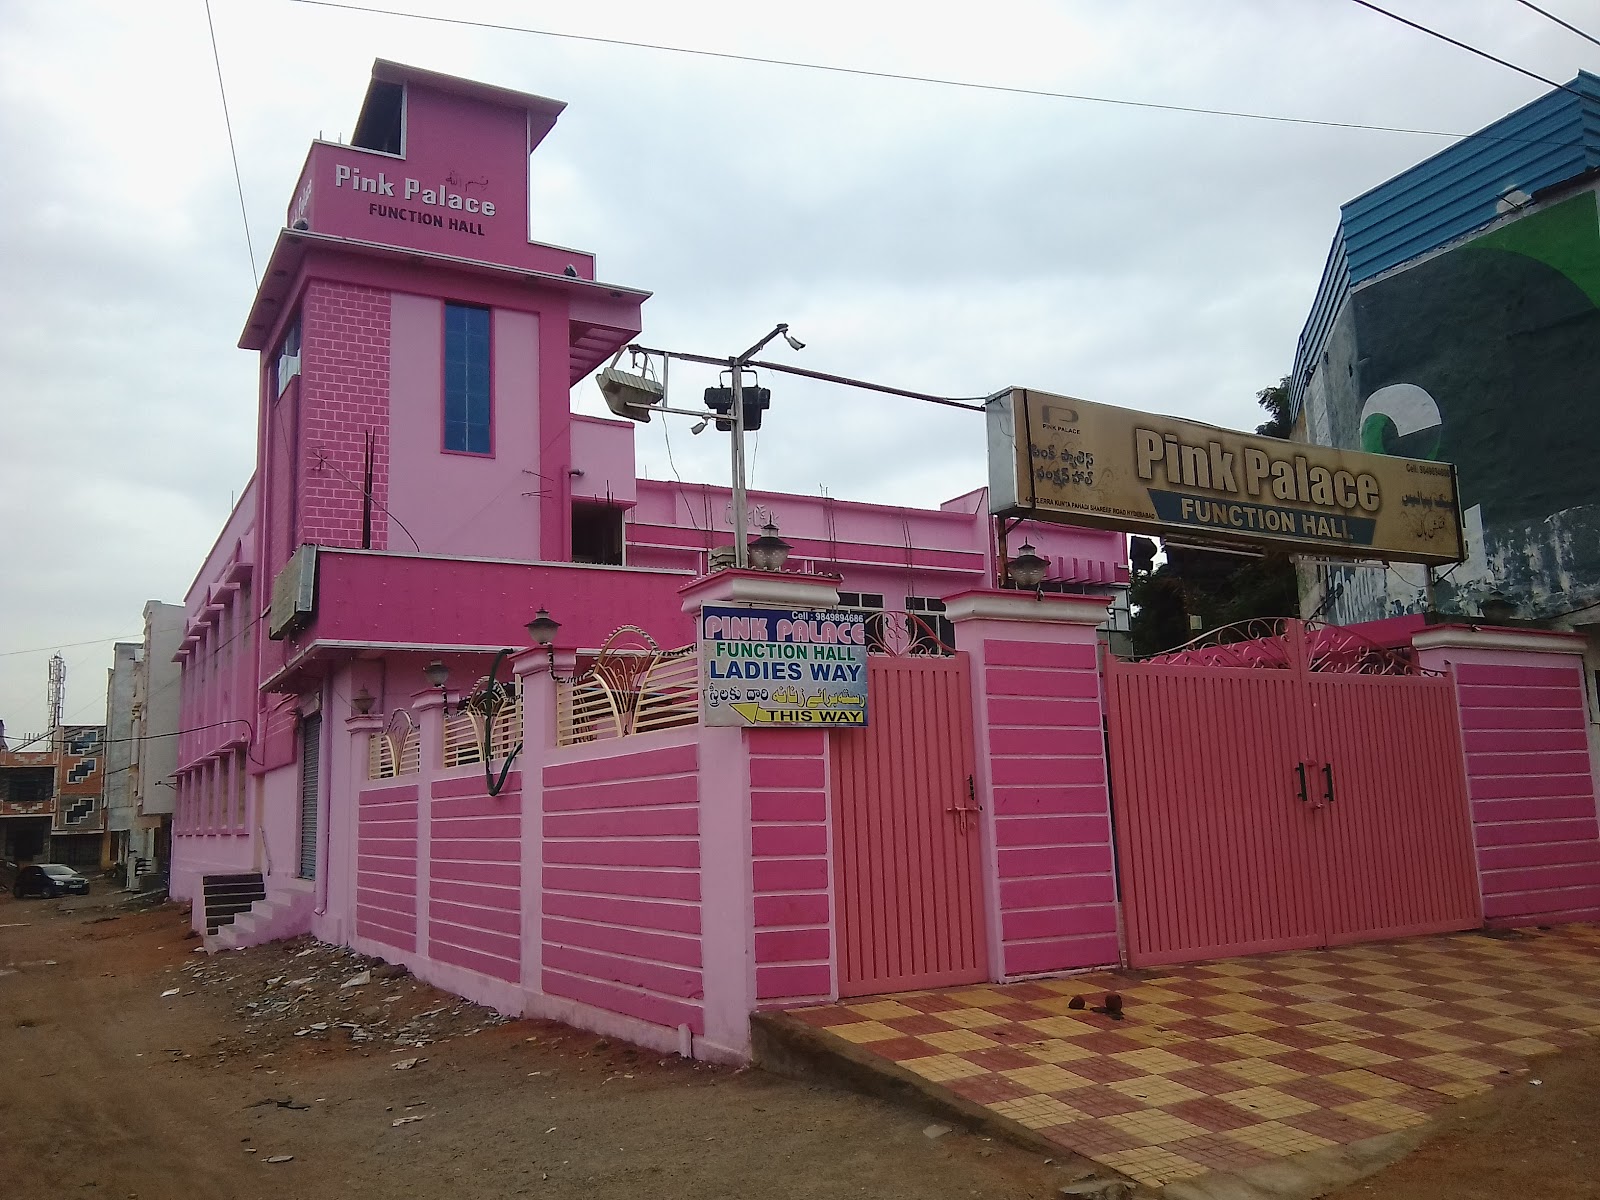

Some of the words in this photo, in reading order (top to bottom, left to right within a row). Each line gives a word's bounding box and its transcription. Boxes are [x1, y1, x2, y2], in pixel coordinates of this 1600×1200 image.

[335, 163, 395, 197] Pink
[404, 177, 496, 216] Palace
[369, 202, 443, 228] FUNCTION
[449, 217, 485, 236] HALL
[1057, 426, 1080, 435] PALACE
[1135, 428, 1238, 493] Pink
[1244, 448, 1380, 512] Palace
[1112, 507, 1126, 515] ROAD
[1181, 497, 1296, 533] FUNCTION
[1301, 514, 1354, 539] HALL
[791, 610, 809, 620] Cell
[815, 612, 864, 623] 9849894686
[705, 615, 769, 641] PINK
[776, 618, 865, 645] PALACE
[716, 642, 808, 660] FUNCTION
[813, 645, 856, 661] HALL
[710, 660, 802, 681] LADIES
[810, 663, 862, 682] WAY
[766, 710, 813, 722] THIS
[819, 711, 861, 722] WAY
